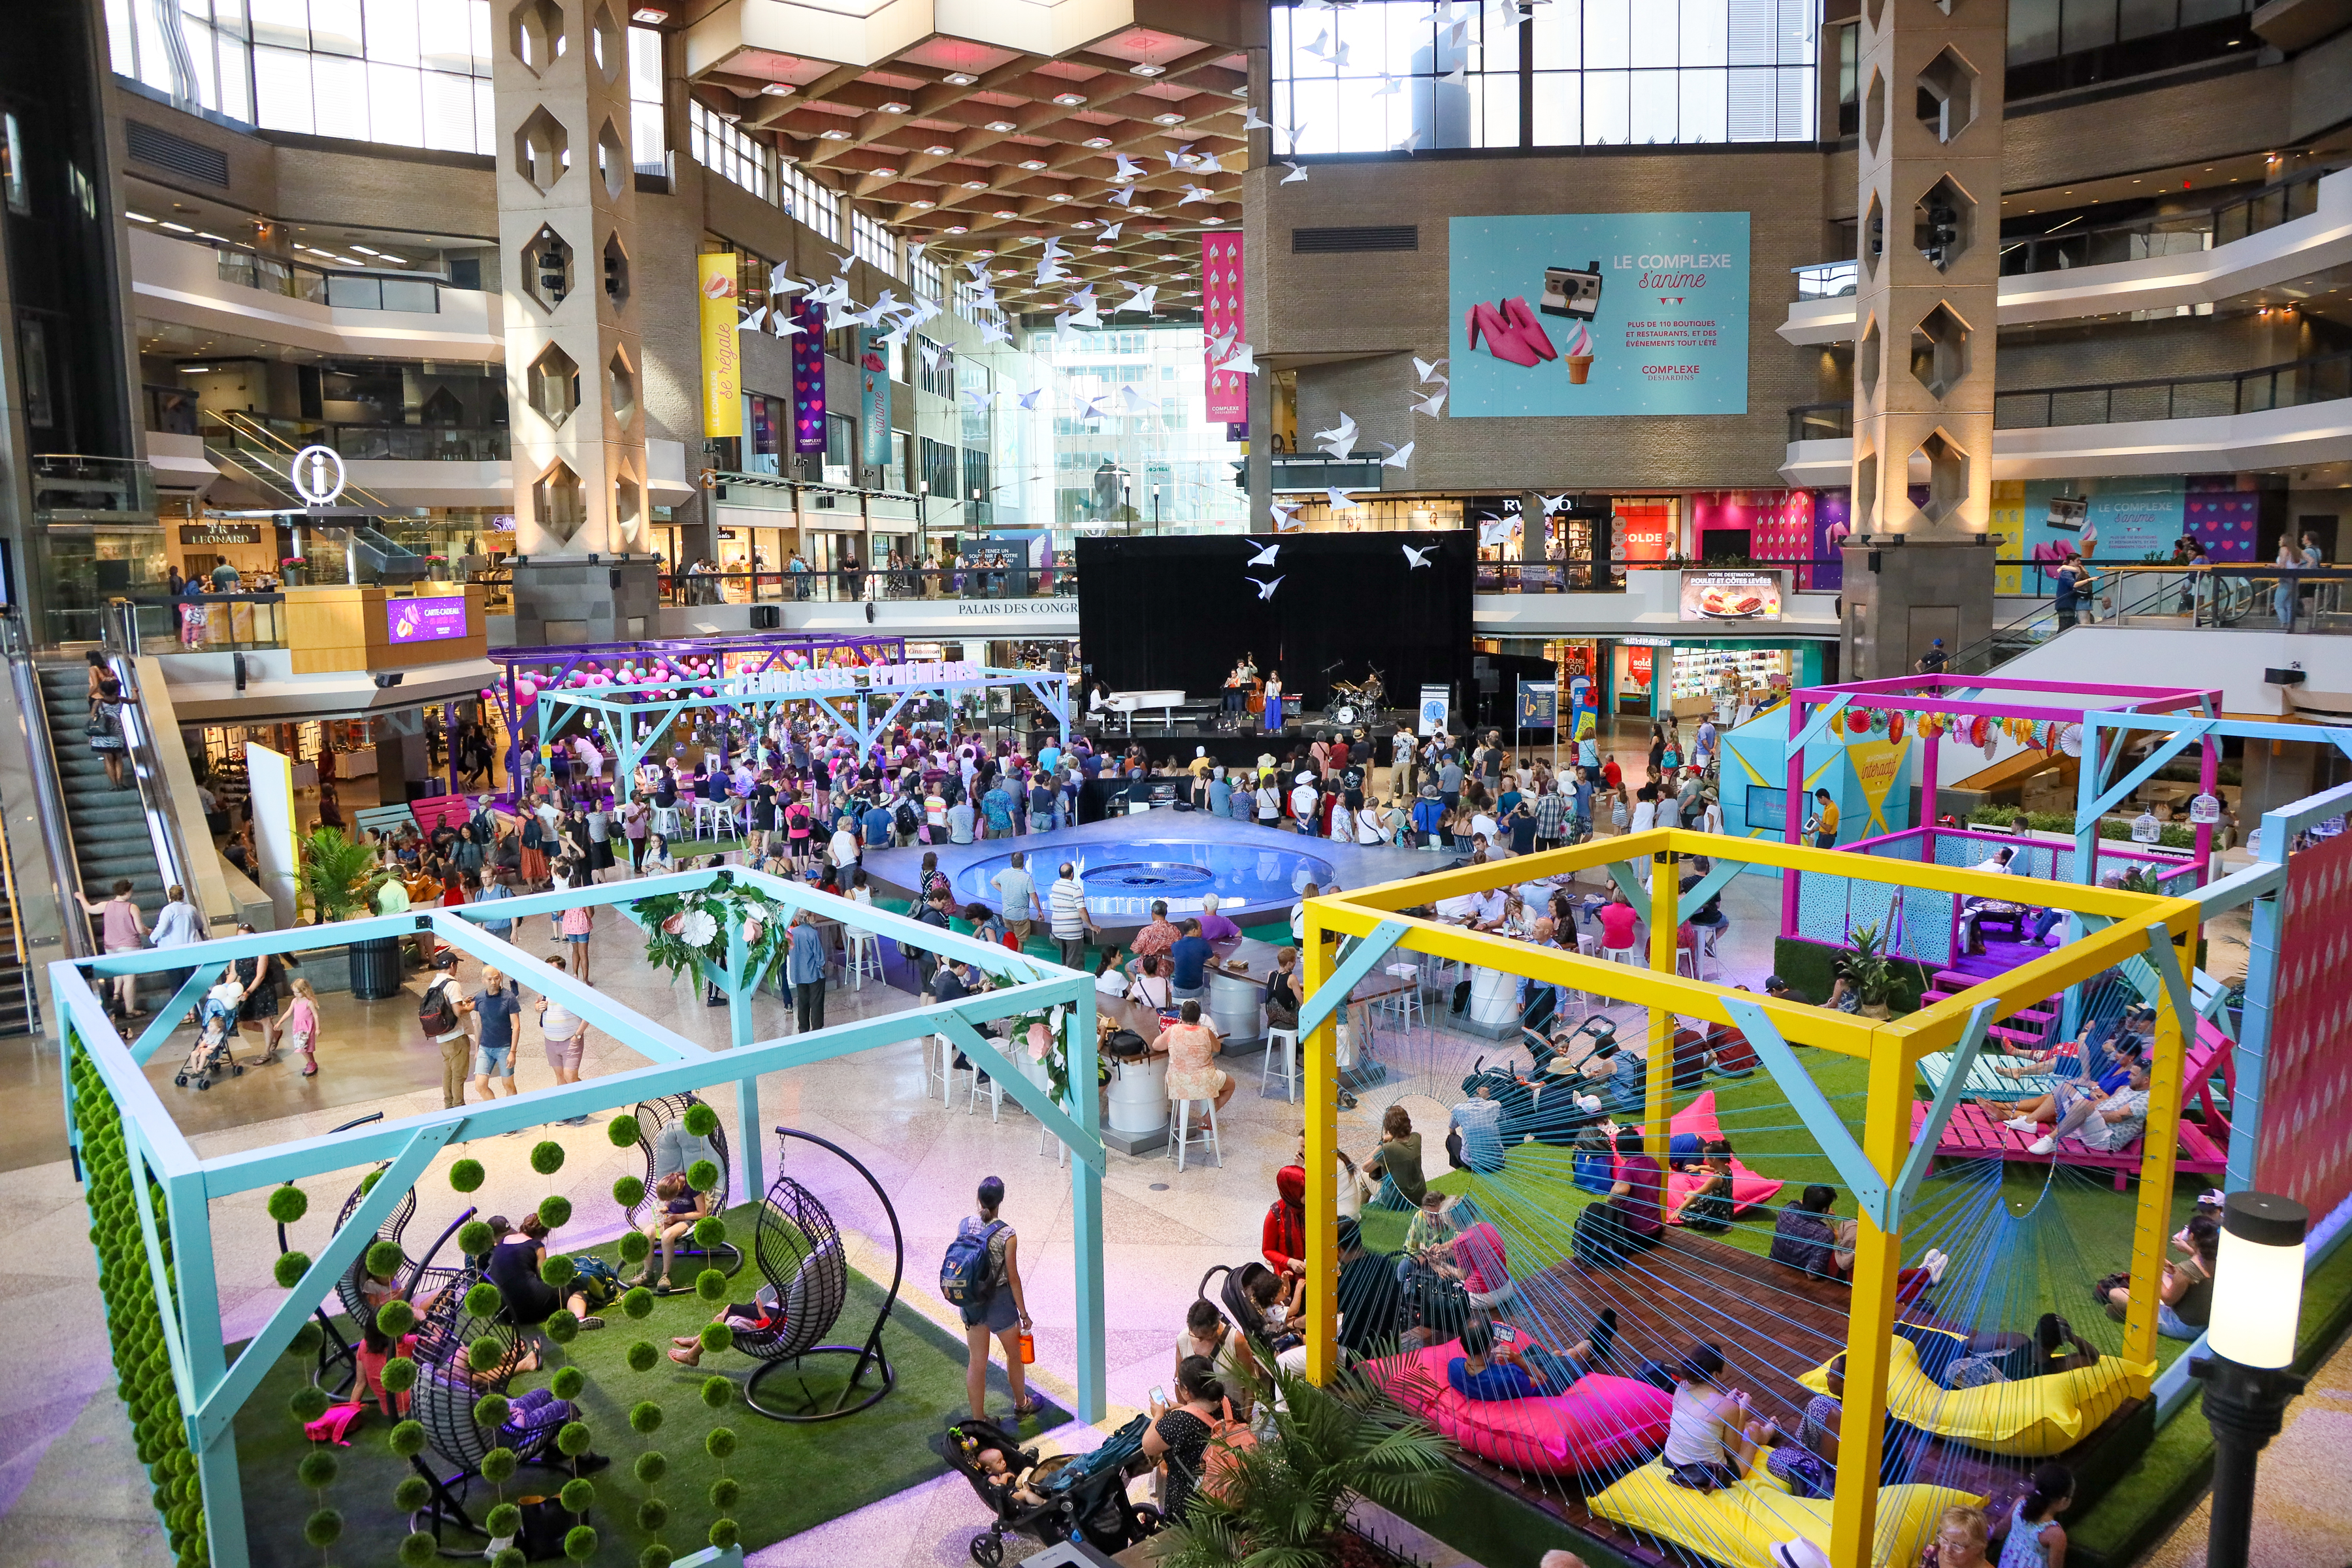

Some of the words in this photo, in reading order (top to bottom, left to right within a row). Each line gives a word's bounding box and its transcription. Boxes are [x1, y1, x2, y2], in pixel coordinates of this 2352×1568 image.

[1614, 255, 1632, 269] LE
[1638, 254, 1731, 269] COMPLEXE
[1639, 270, 1707, 288] s'anime
[715, 323, 738, 374] régale
[1642, 365, 1700, 374] COMPLEXE
[711, 370, 719, 414] COMPLEXE
[719, 380, 733, 399] se
[874, 391, 885, 436] s'anime
[712, 416, 719, 427] LE
[2114, 502, 2172, 511] COMPLEXE
[2114, 512, 2155, 523] s'anime
[192, 535, 249, 544] LEONARD
[1625, 533, 1662, 542] OLDE
[424, 608, 459, 616] CARTE-CADEAU
[958, 604, 1000, 614] PALAIS
[1004, 603, 1028, 613] DES
[1031, 602, 1079, 613] CONGR
[1633, 658, 1652, 666] sold
[733, 668, 855, 696] TERRASSES
[869, 659, 978, 687] ÉPHÉMÈRES
[1861, 754, 1898, 781] interactif
